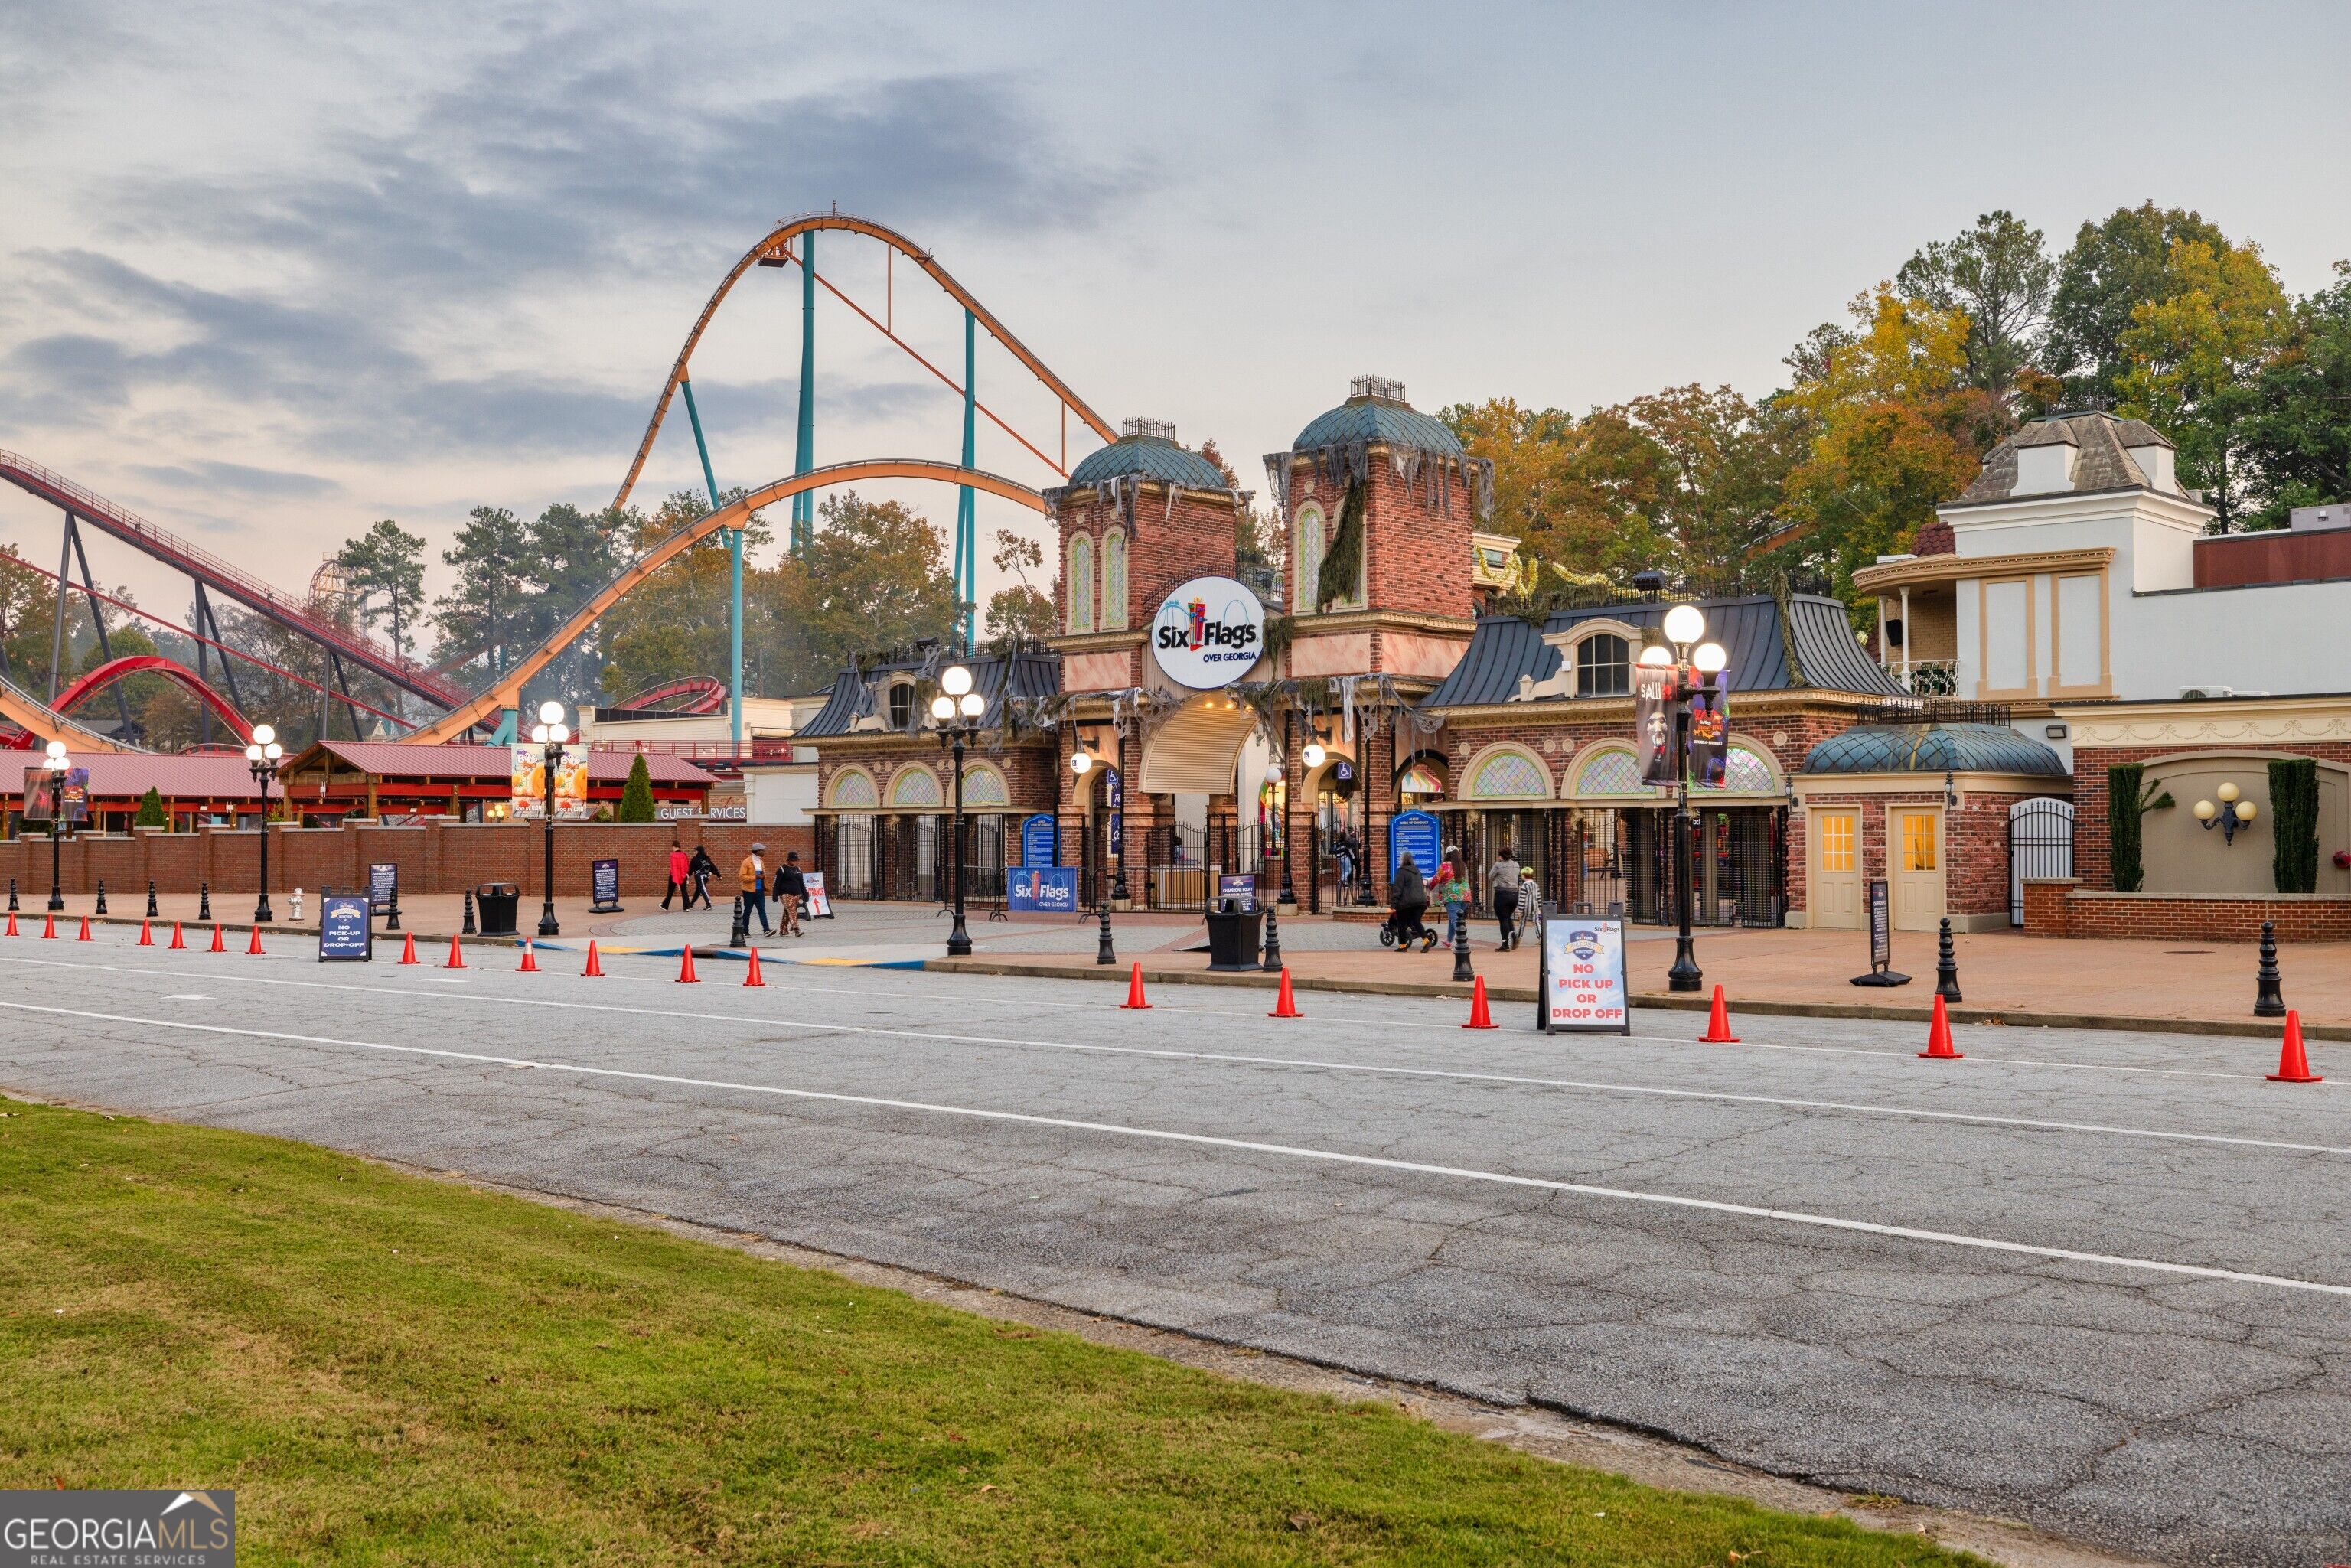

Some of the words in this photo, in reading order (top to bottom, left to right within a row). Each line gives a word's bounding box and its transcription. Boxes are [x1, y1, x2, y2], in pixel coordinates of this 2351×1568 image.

[1158, 625, 1189, 649] Six
[1204, 621, 1257, 649] Flags
[1203, 654, 1221, 663] OVER
[1224, 651, 1257, 661] GEORGIA
[660, 807, 693, 819] GUEST
[698, 807, 745, 819] SRVICES
[808, 888, 825, 896] TRANCE
[1015, 885, 1032, 898] Six
[1040, 885, 1069, 900] Flags
[1573, 964, 1594, 973] NO
[1559, 980, 1591, 988] PICK
[1594, 980, 1613, 989] UP
[1577, 994, 1596, 1003] OR
[1552, 1009, 1591, 1018] DROP
[1595, 1009, 1622, 1019] OFF
